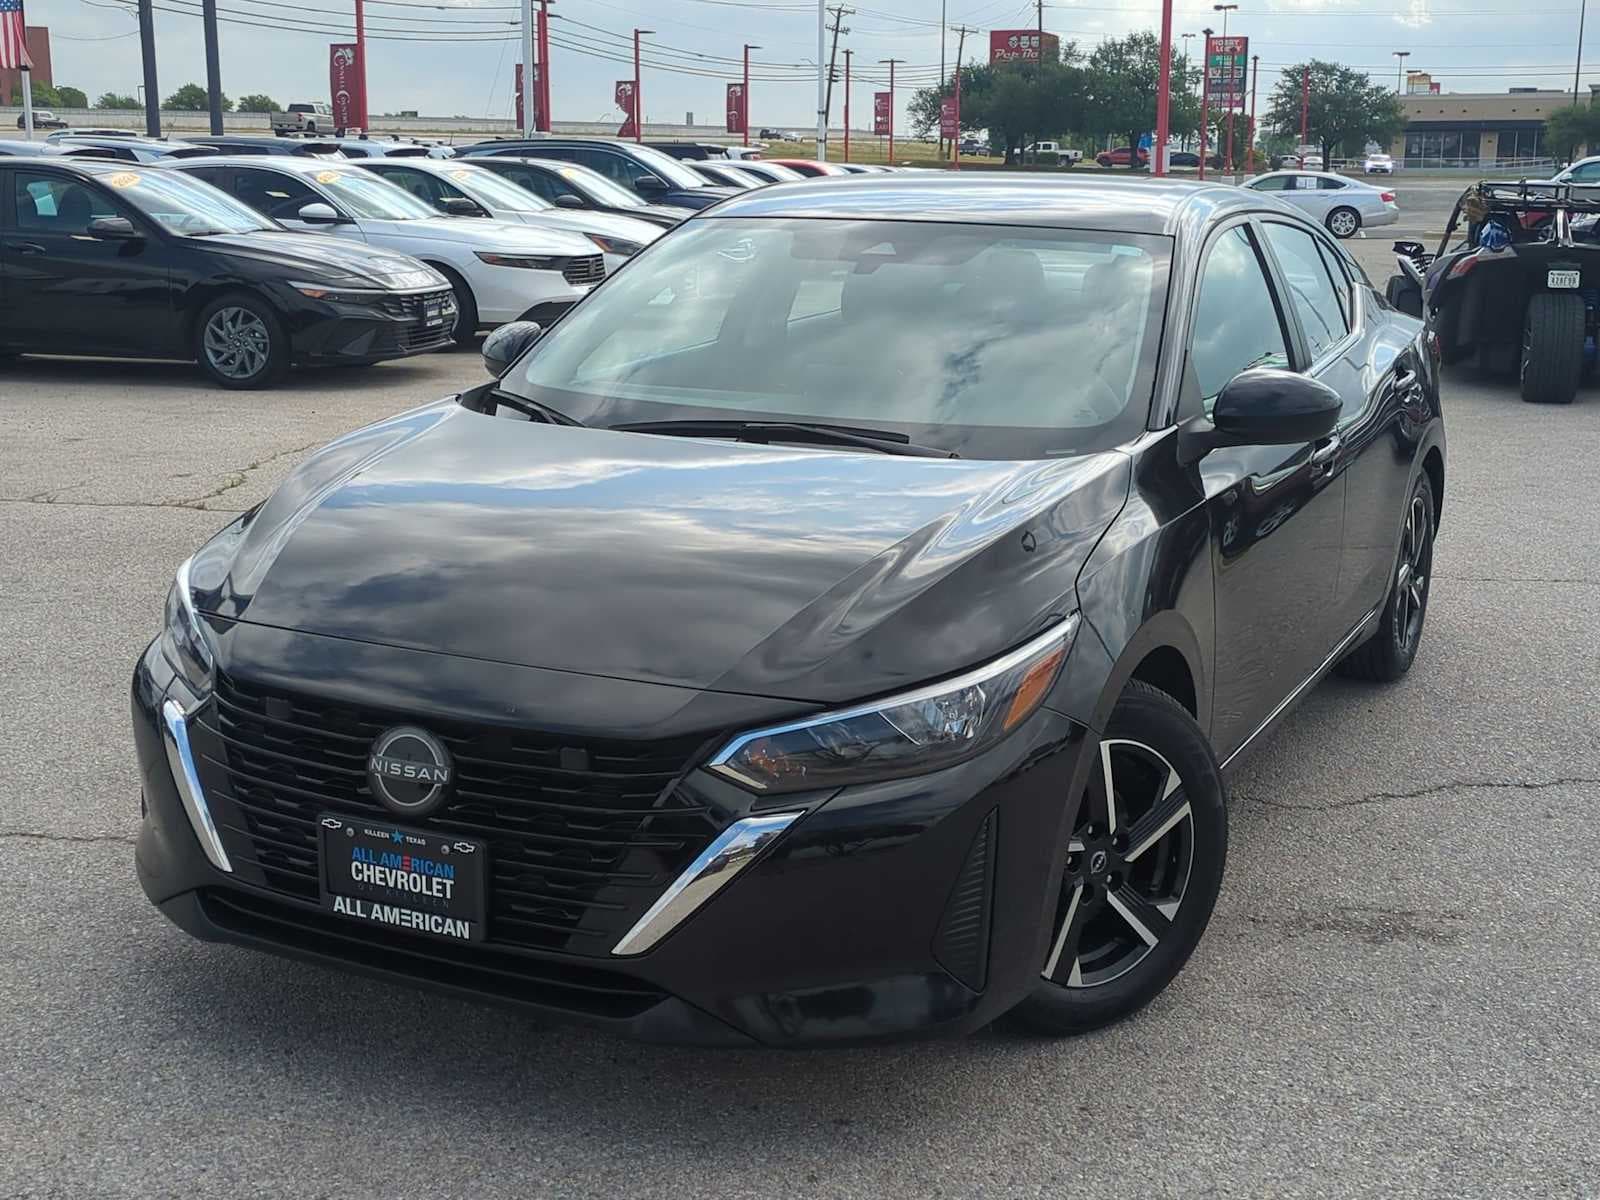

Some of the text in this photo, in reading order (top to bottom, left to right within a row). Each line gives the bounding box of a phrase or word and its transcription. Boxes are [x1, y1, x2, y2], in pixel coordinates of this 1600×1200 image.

[371, 757, 448, 782] NISSAN
[406, 836, 426, 846] TEXAS
[351, 847, 455, 879] ALL AMERICAN
[351, 861, 455, 900] CHEVROLET
[333, 895, 471, 940] ALL AMERICAN
